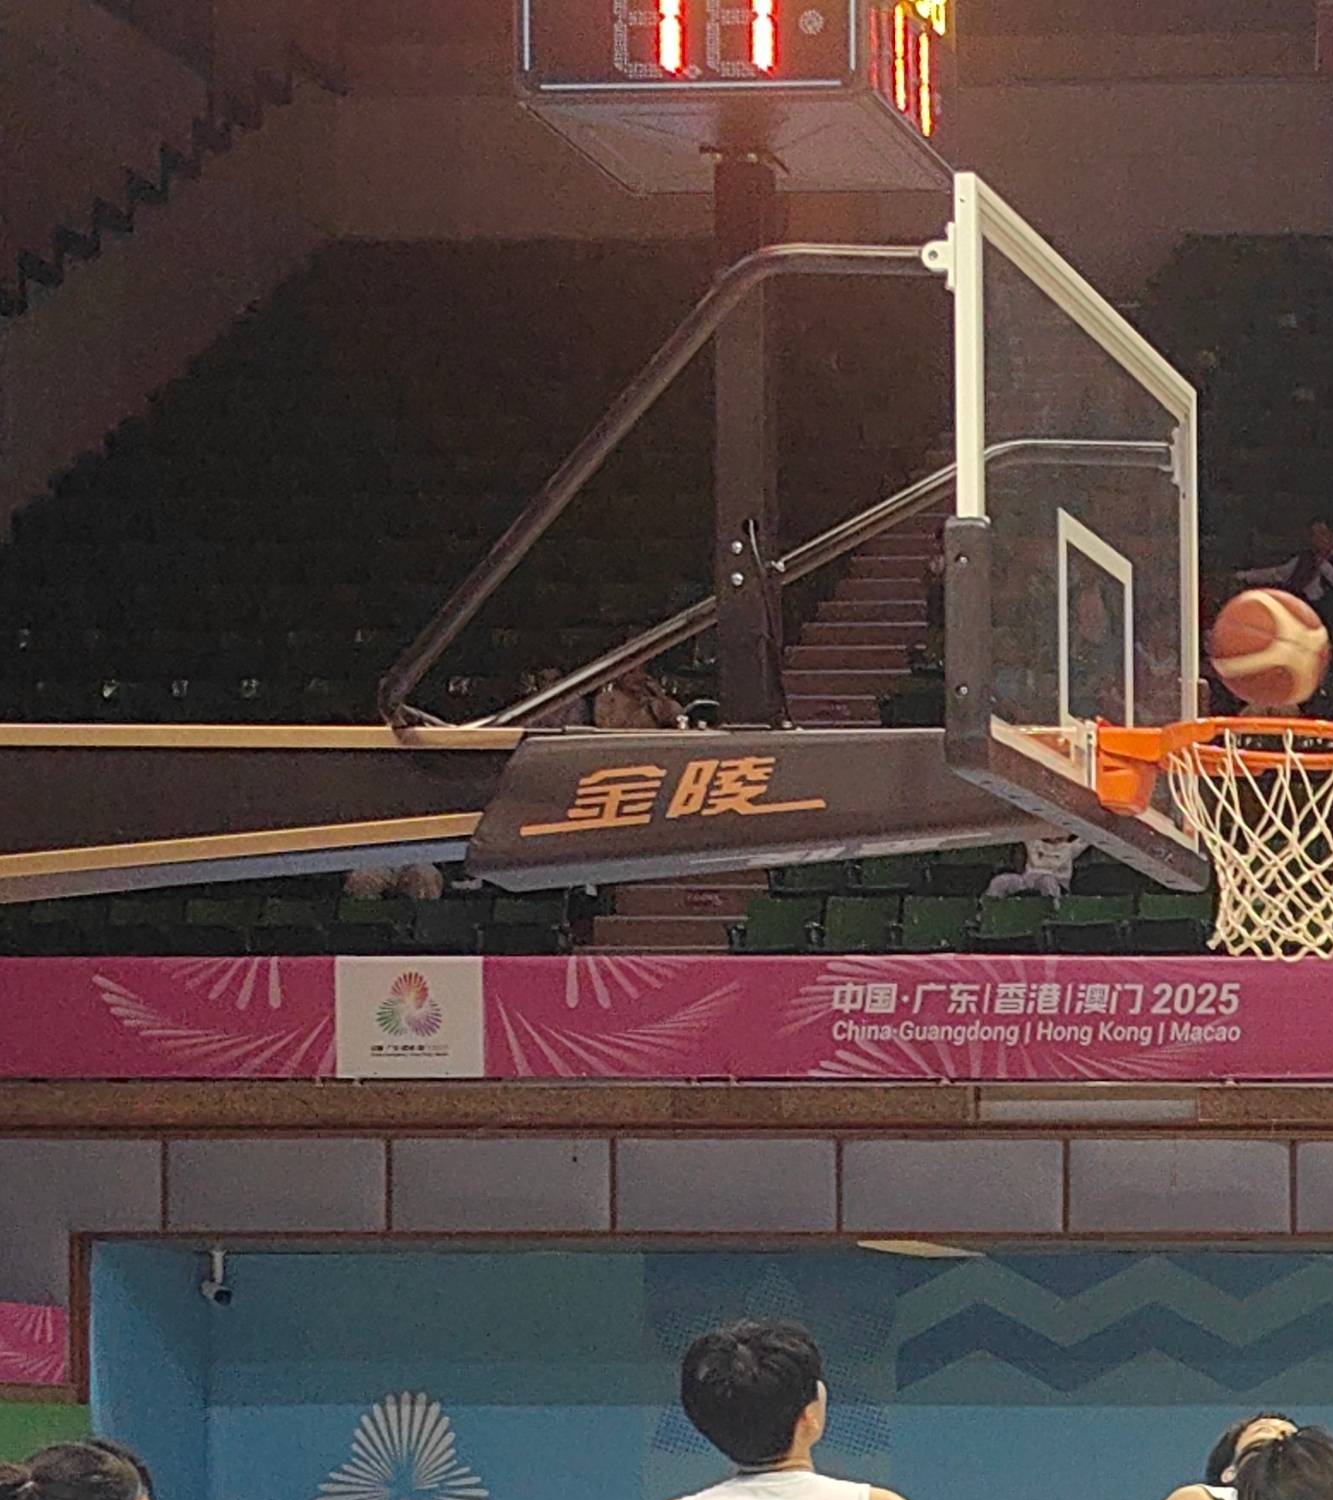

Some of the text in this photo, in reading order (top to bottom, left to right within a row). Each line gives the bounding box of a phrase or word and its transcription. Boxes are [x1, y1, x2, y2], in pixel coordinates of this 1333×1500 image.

[520, 756, 826, 837] 金陵
[1151, 983, 1241, 1015] 2025
[1036, 1020, 1093, 1046] Hong
[1100, 1020, 1153, 1046] Kong
[1170, 1021, 1241, 1042] Macao
